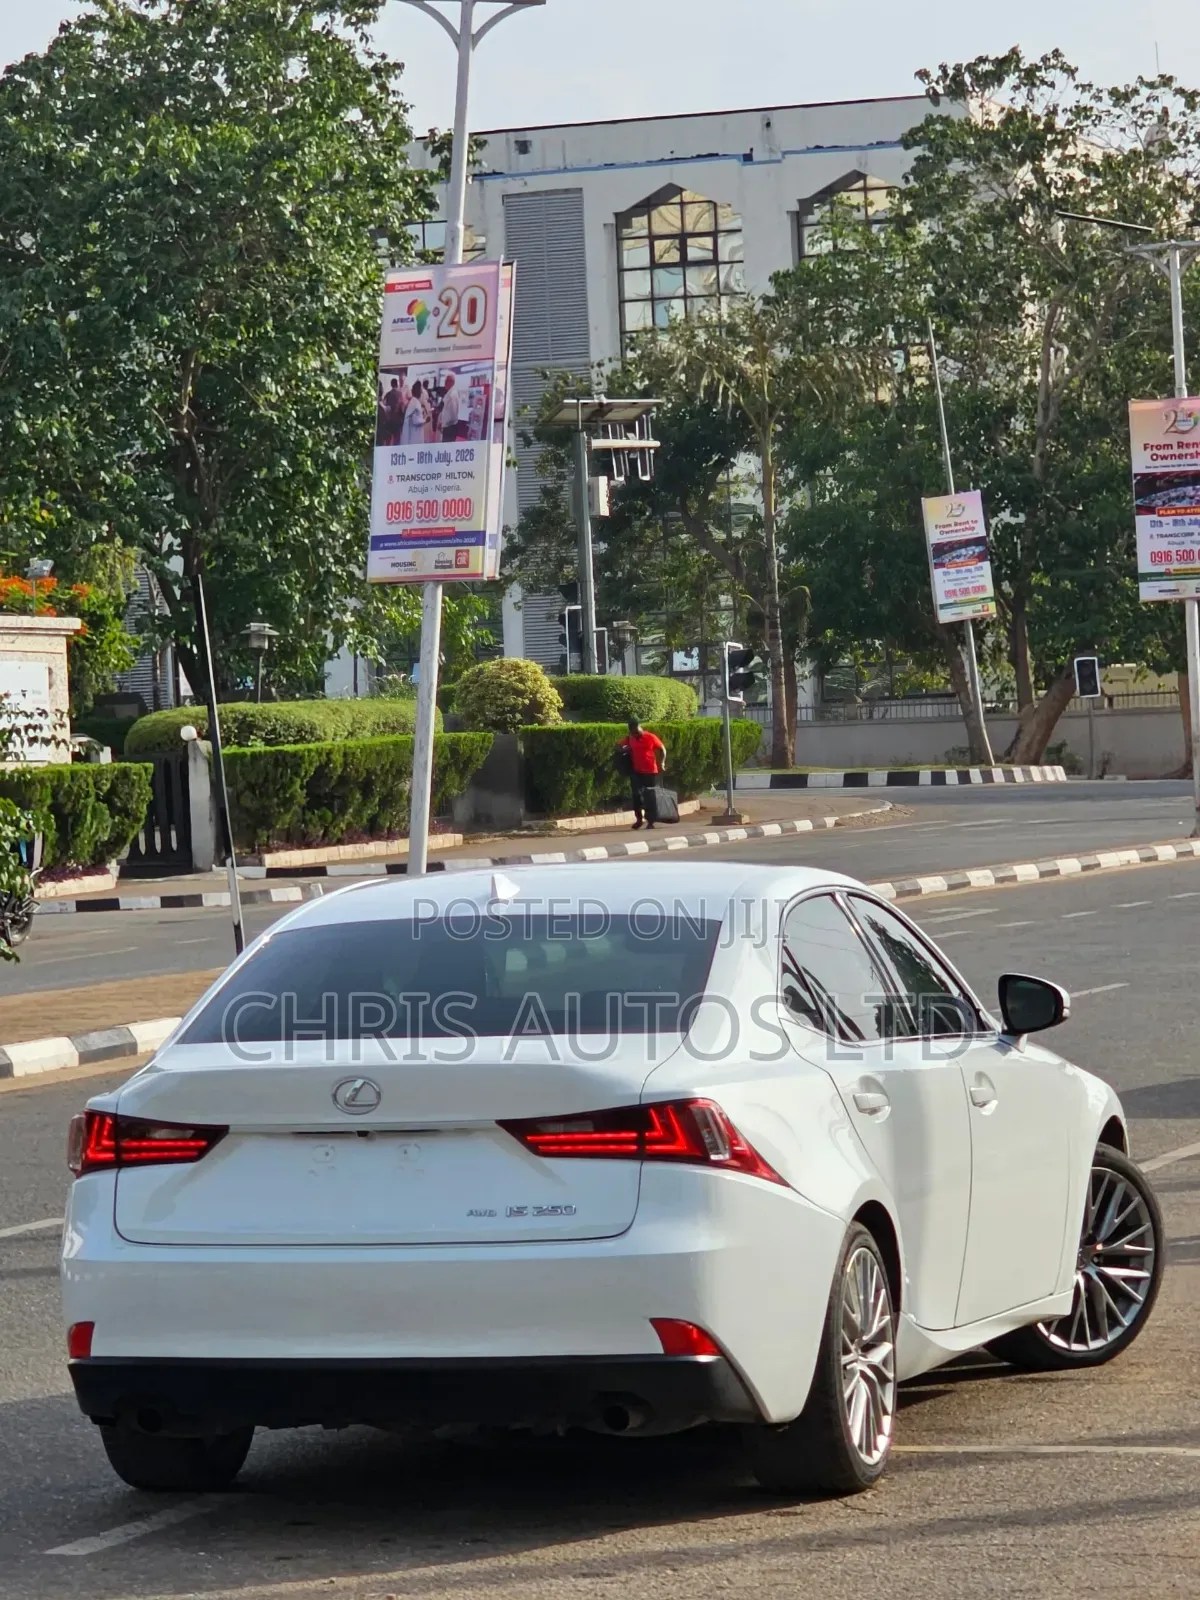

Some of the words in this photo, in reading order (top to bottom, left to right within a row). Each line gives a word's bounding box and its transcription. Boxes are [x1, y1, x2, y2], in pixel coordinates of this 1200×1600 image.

[436, 284, 488, 339] 20
[1143, 442, 1173, 451] From
[390, 452, 407, 466] 13th
[417, 450, 433, 464] 18th
[455, 448, 475, 462] 2026
[396, 472, 442, 482] TRANSCORP
[445, 470, 475, 481] HILTON,
[408, 485, 429, 494] Abuja
[386, 500, 413, 521] 0916
[416, 499, 439, 520] 500
[442, 498, 472, 518] 0000
[939, 526, 976, 536] Ownership
[1150, 550, 1173, 563] 0916
[1176, 549, 1195, 562] 500
[391, 560, 417, 568] HOUSING
[466, 1208, 498, 1218] AWD
[505, 1204, 528, 1218] IS
[532, 1203, 577, 1217] 250
